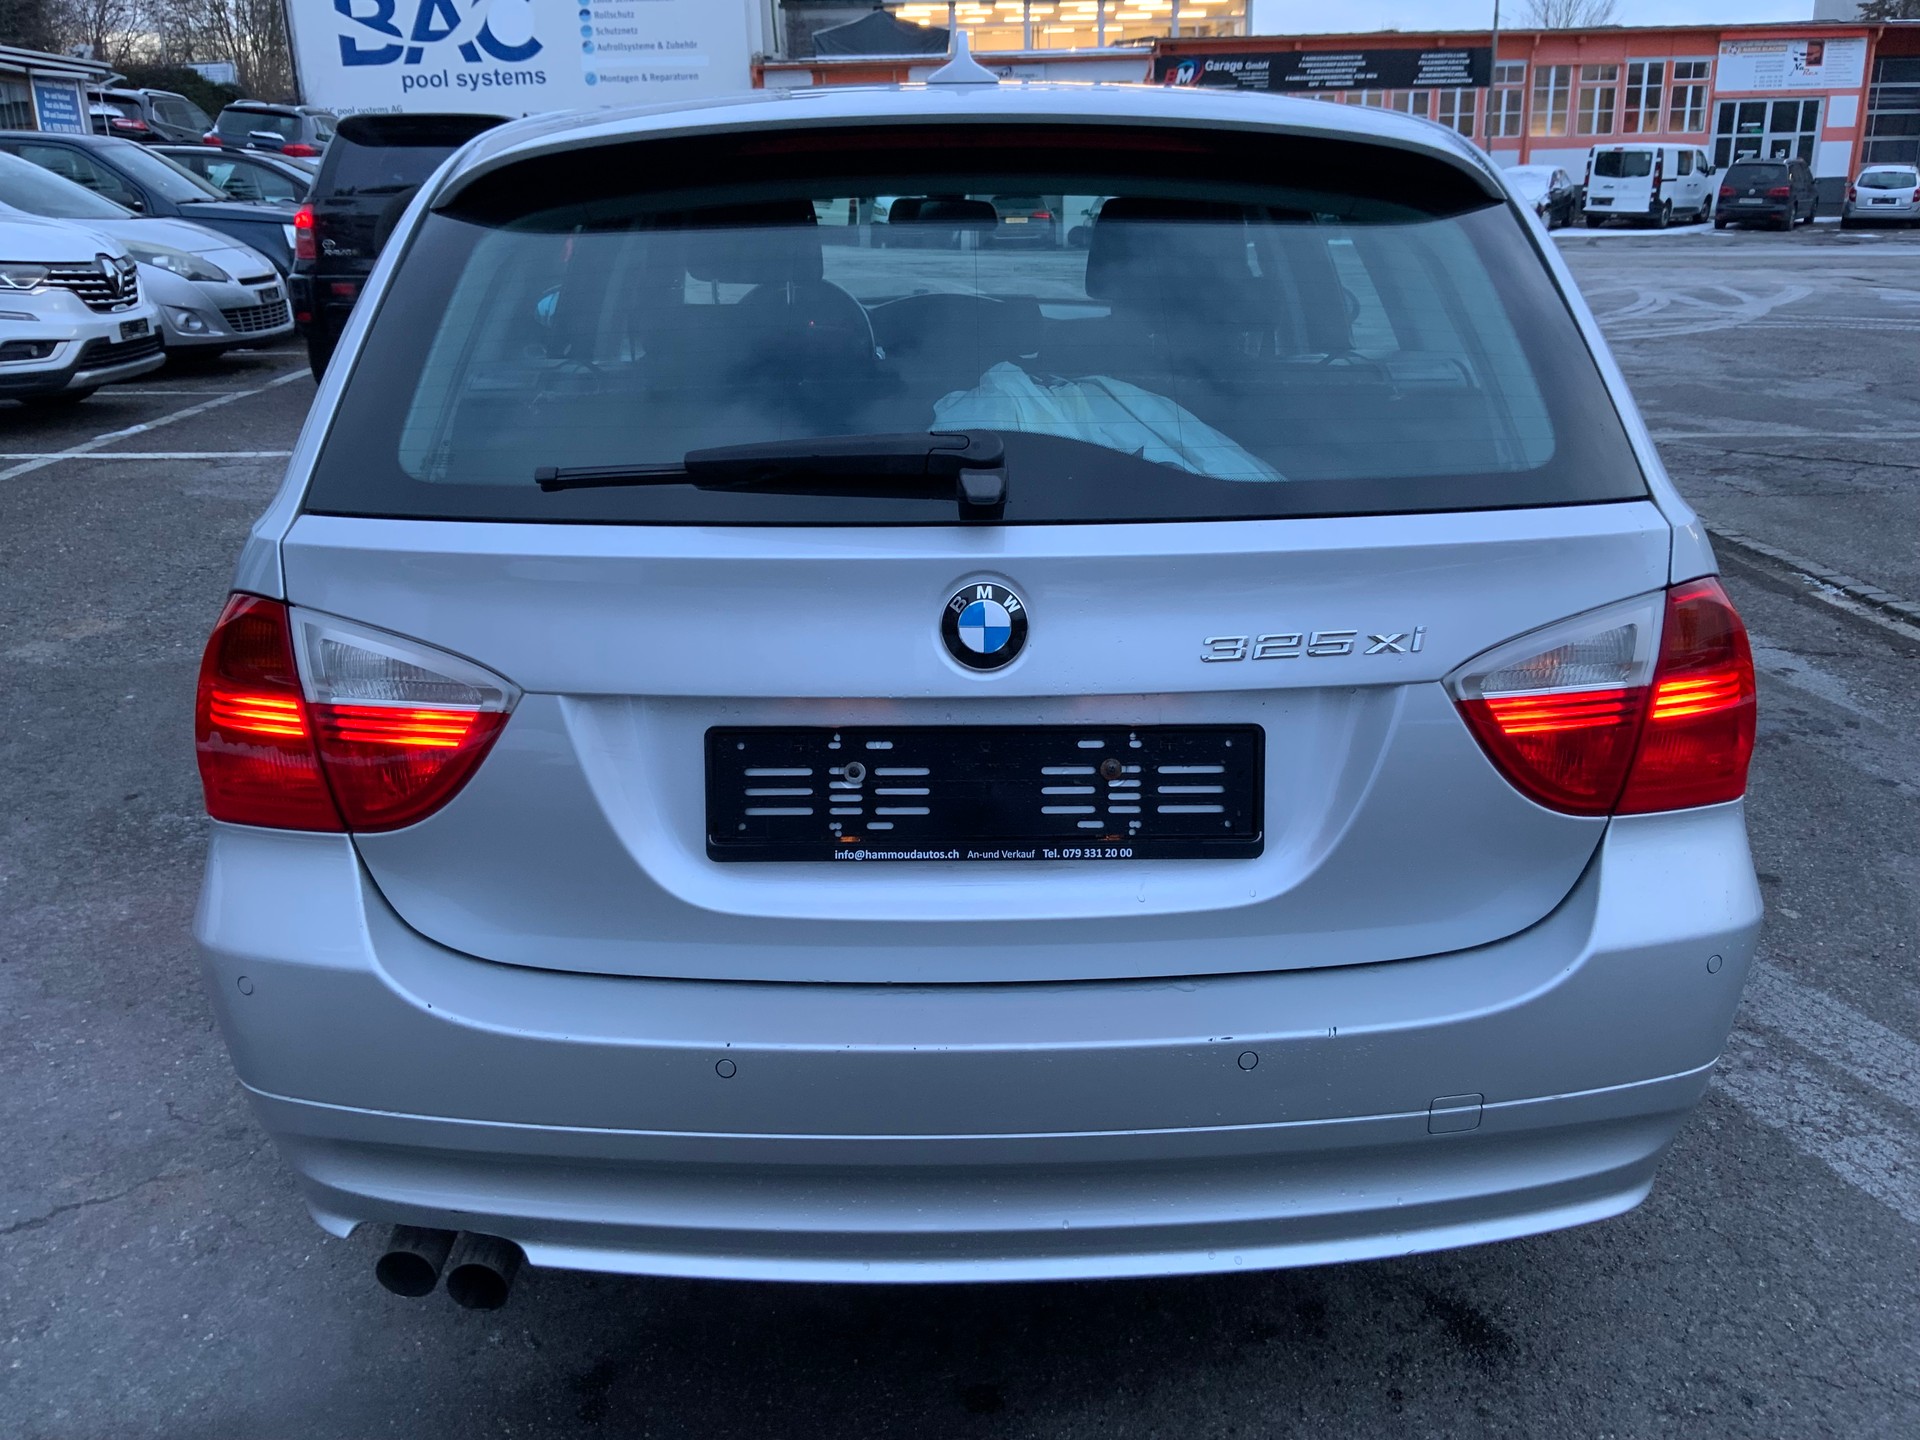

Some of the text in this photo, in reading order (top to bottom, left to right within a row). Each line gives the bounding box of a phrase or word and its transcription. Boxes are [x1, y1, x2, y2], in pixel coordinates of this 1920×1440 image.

[593, 11, 635, 19] Rollschutz
[595, 27, 638, 35] Schutznetz
[597, 40, 698, 52] Aufrollsysteme & Zubehör
[1205, 60, 1243, 73] Garage
[1245, 61, 1269, 70] GmbH
[402, 68, 546, 93] pool systems
[600, 72, 699, 84] Montagen & Reparaturen
[337, 106, 356, 117] pool
[357, 105, 388, 114] systems
[391, 105, 403, 114] AG
[949, 585, 1021, 613] BMW
[834, 848, 1133, 861] info@hammoudautos.ch An-und Verkauf Tel. 079 331 20 00
